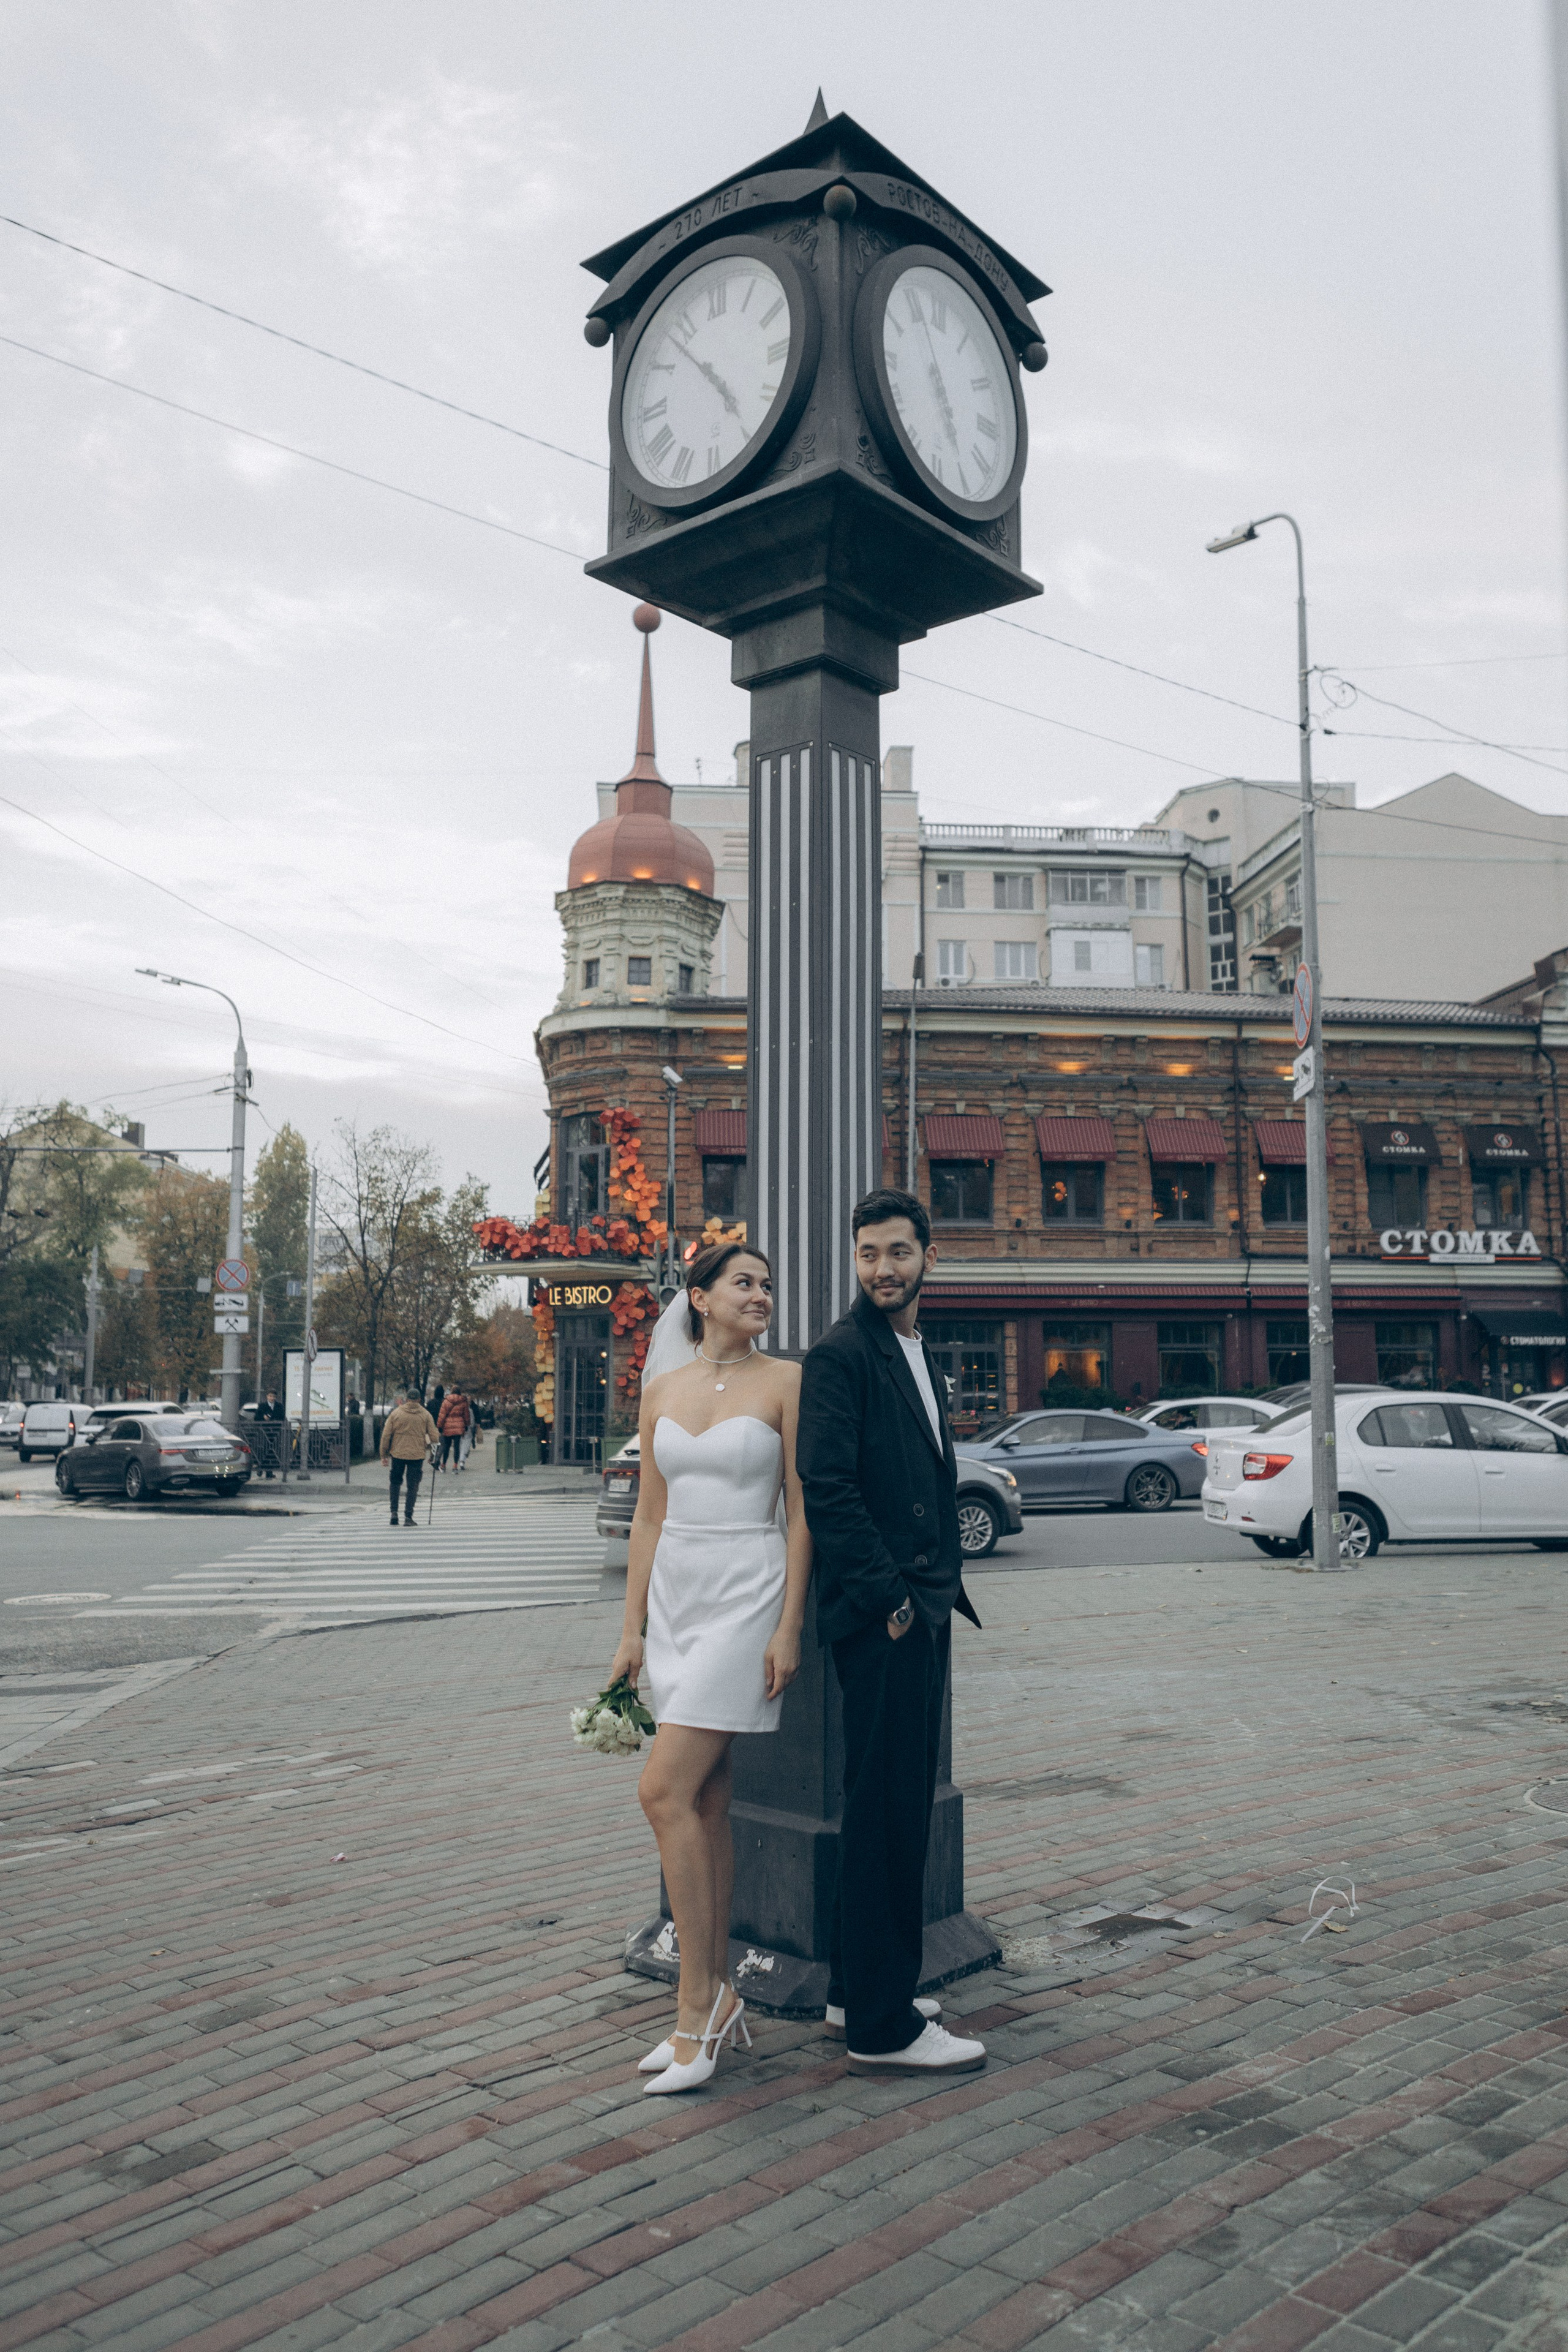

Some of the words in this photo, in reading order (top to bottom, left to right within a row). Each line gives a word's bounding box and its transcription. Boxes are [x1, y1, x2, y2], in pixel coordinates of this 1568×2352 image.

[675, 208, 702, 239] 270
[712, 187, 742, 217] ЛЕТ
[1379, 1229, 1542, 1254] СТОМКА
[549, 1287, 562, 1305] LE
[565, 1285, 612, 1305] BISTRO
